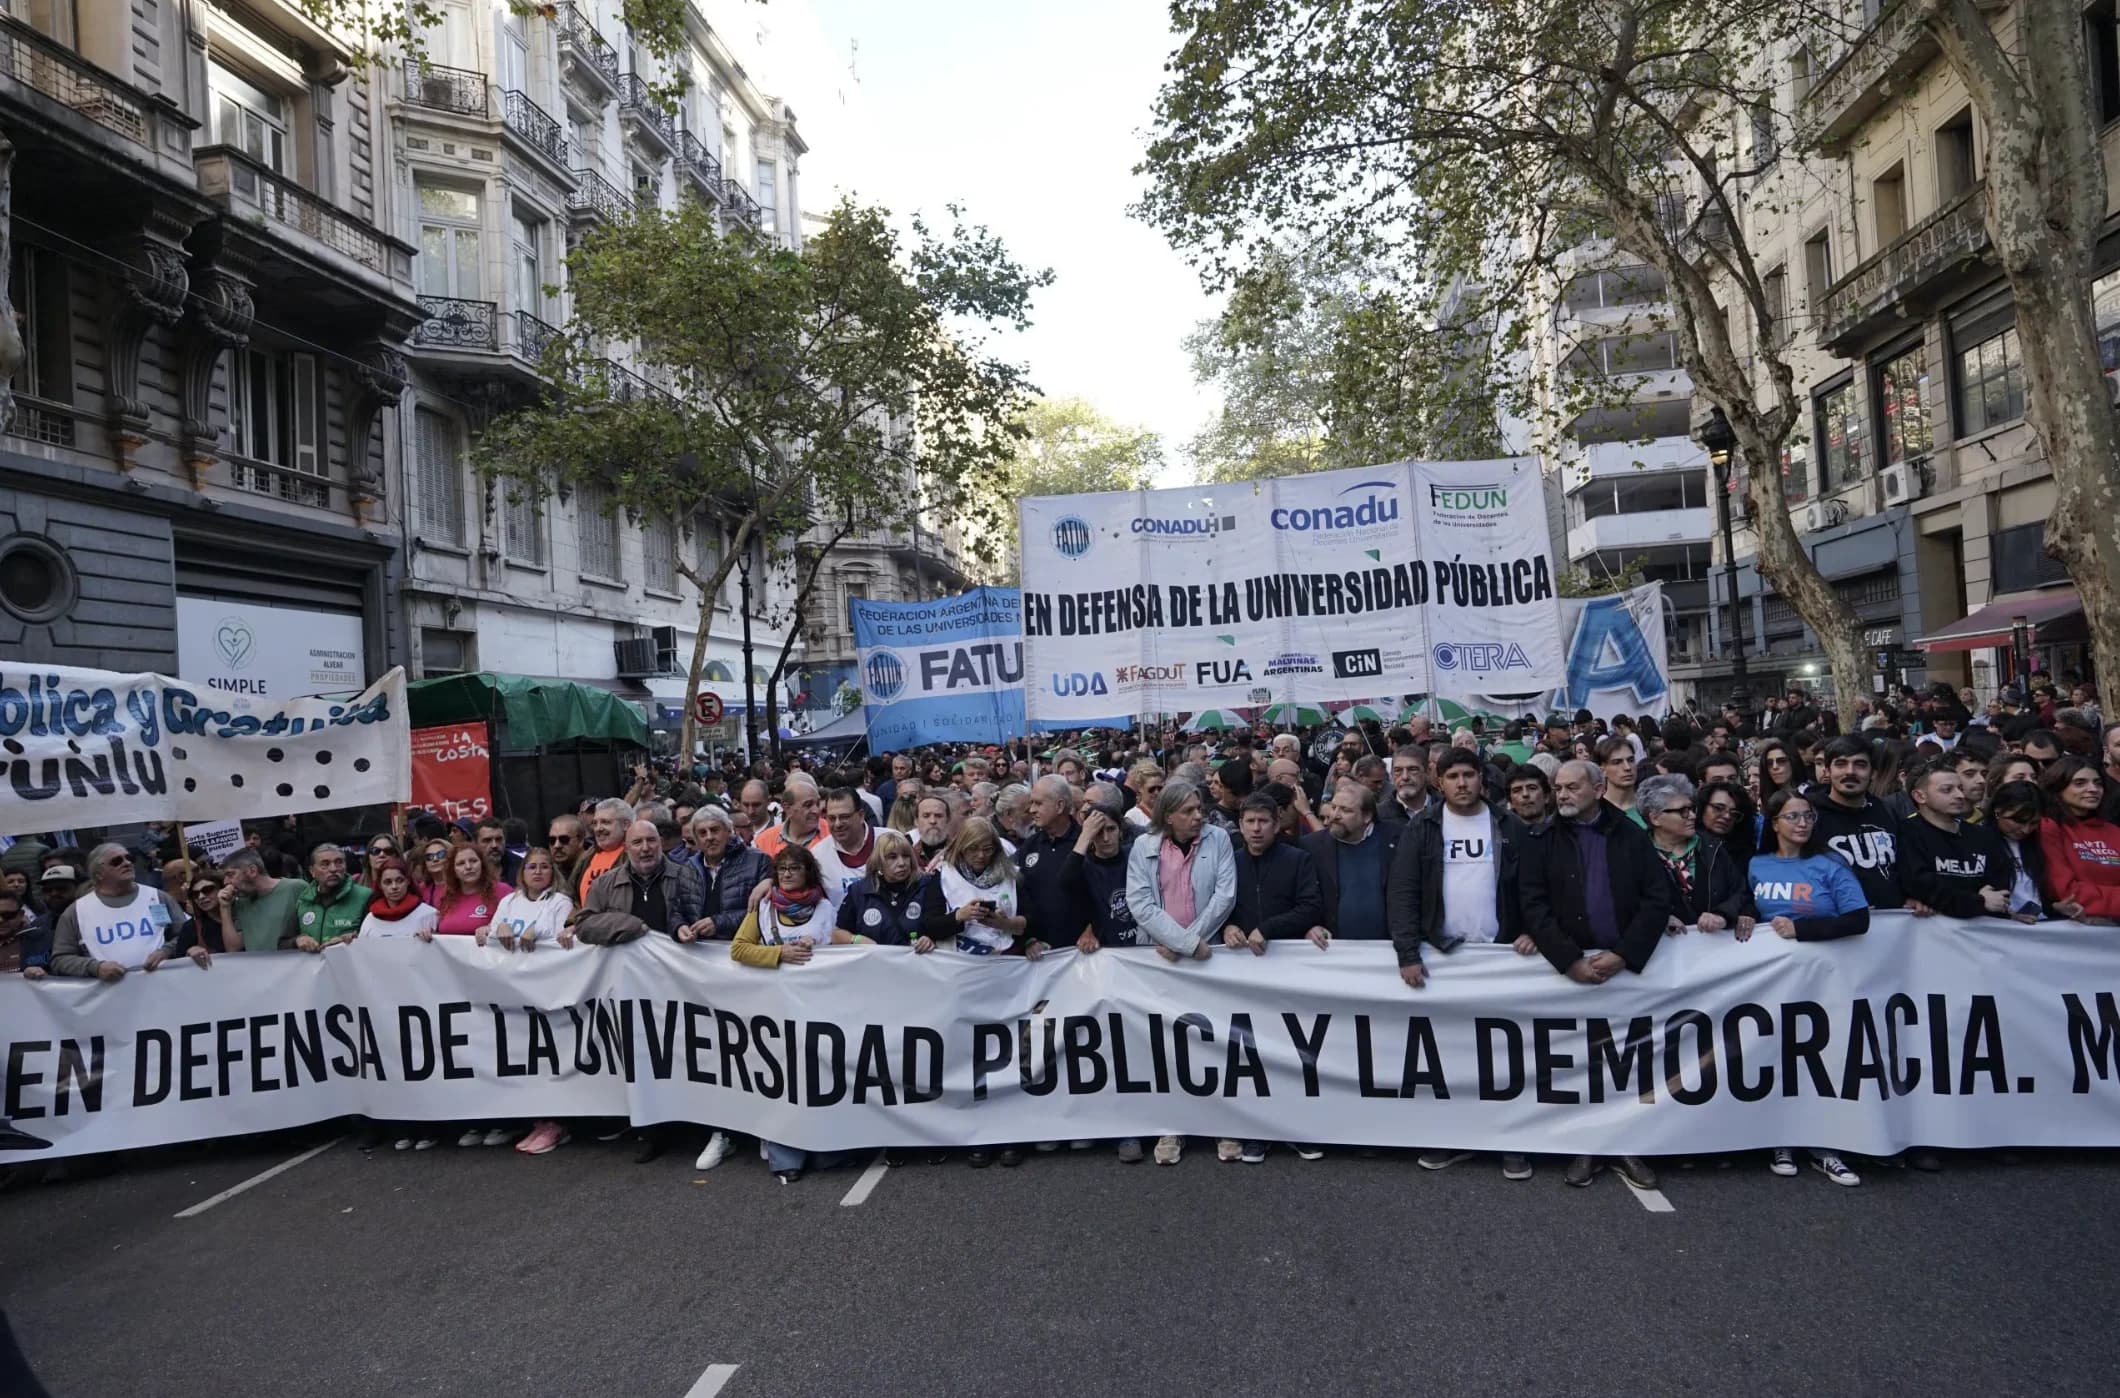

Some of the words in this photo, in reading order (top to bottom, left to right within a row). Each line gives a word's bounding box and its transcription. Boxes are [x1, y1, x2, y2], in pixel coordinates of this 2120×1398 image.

[1430, 484, 1507, 509] FEDUN
[1271, 496, 1398, 531] conadu
[1024, 592, 1053, 636] EN
[1058, 584, 1164, 636] DEFENSA
[1168, 585, 1203, 627] DE
[1208, 582, 1241, 625] LA
[1245, 559, 1429, 622] UNIVERSIDAD
[1433, 554, 1553, 608] PÚBLICA
[858, 608, 936, 621] FEDERACION
[940, 596, 999, 618] ARGENTINA
[1002, 598, 1020, 609] DE
[877, 625, 896, 635] DE
[898, 624, 922, 635] LAS
[926, 612, 1013, 633] UNIVERSIDADES
[919, 642, 1024, 691] FATU
[1268, 657, 1316, 667] MALVINAS
[1433, 642, 1533, 671] CTERA
[1130, 663, 1187, 681] FAGDUT
[1196, 659, 1253, 685] FUA
[1263, 665, 1323, 676] ARGENTINAS
[208, 677, 268, 694] SIMPLE
[1053, 671, 1109, 697] UDA
[873, 722, 917, 739] UNIDAD
[1828, 831, 1896, 868] SUR
[1754, 882, 1813, 900] MNR
[95, 917, 155, 945] UDA
[4, 1036, 104, 1120] EN
[133, 1004, 387, 1107] DEFENSA
[399, 1002, 474, 1081] DE
[489, 1002, 560, 1078] LA
[569, 998, 944, 1108] UNIVERSIDAD
[973, 999, 1271, 1101] PÚBLICA
[1281, 1012, 1332, 1098] Y
[1354, 1014, 1451, 1099] LA
[1474, 992, 2034, 1106] DEMOCRACIA.
